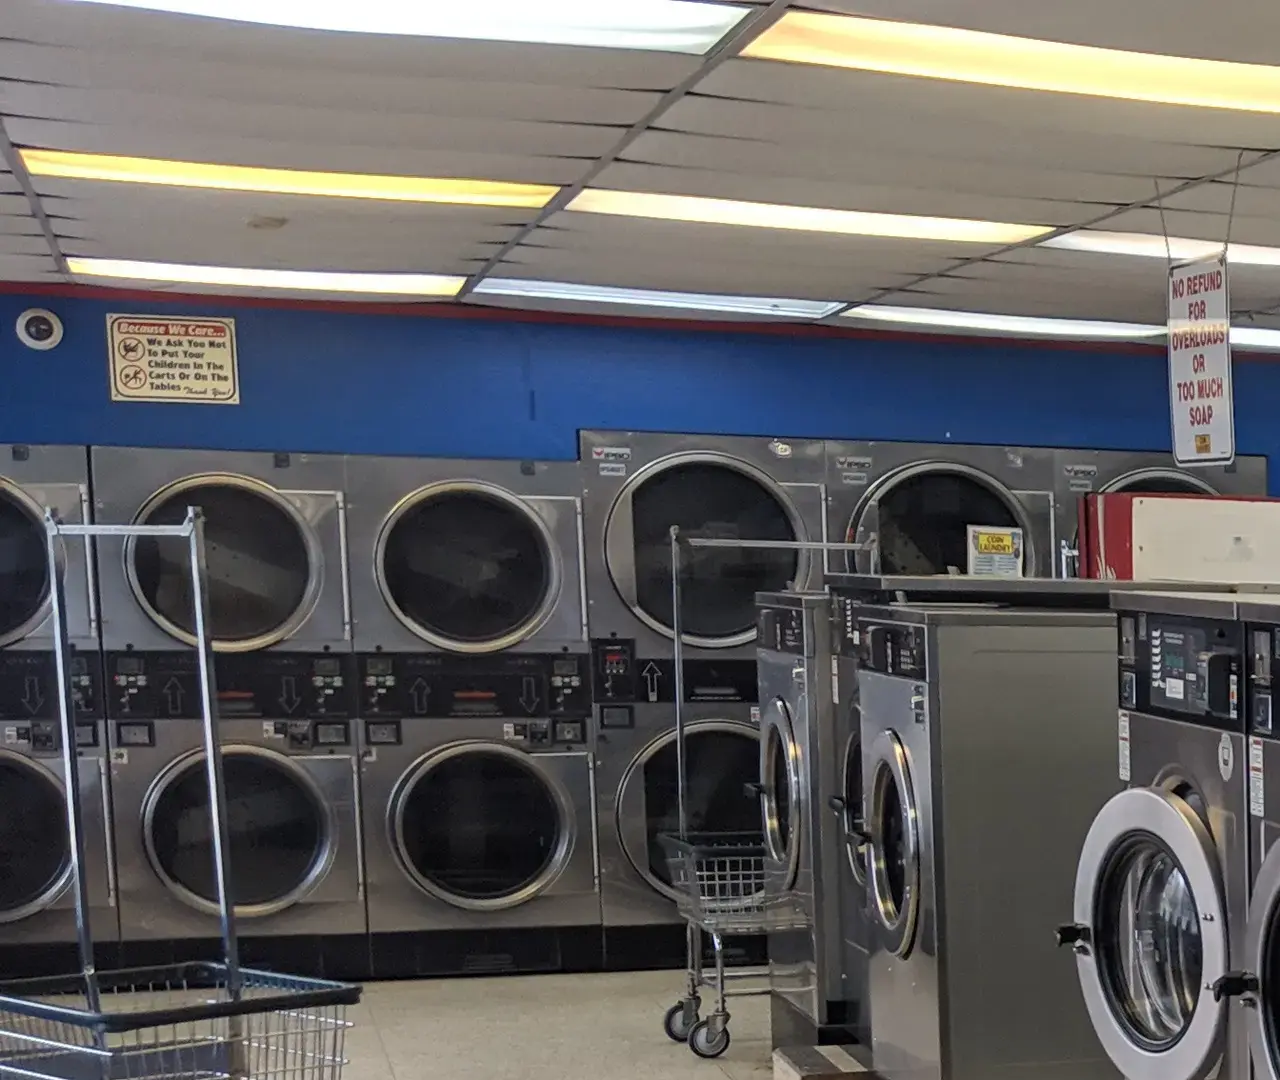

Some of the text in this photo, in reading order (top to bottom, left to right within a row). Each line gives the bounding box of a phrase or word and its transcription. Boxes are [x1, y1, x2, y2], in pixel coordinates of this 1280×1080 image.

[1172, 270, 1222, 299] NO REFUND
[1188, 301, 1206, 320] FOR
[120, 323, 224, 336] Because We Care...
[189, 340, 205, 348] You
[209, 340, 226, 348] Not
[1172, 325, 1225, 351] OVERLOADS
[147, 349, 158, 357] To
[148, 360, 190, 369] Children
[207, 362, 224, 370] The
[1193, 354, 1205, 372] OR
[194, 372, 208, 380] On
[212, 373, 229, 381] The
[150, 382, 181, 391] Tables
[183, 387, 207, 395] Thank
[1177, 377, 1223, 400] TOO MUCH
[1190, 405, 1213, 426] SOAP
